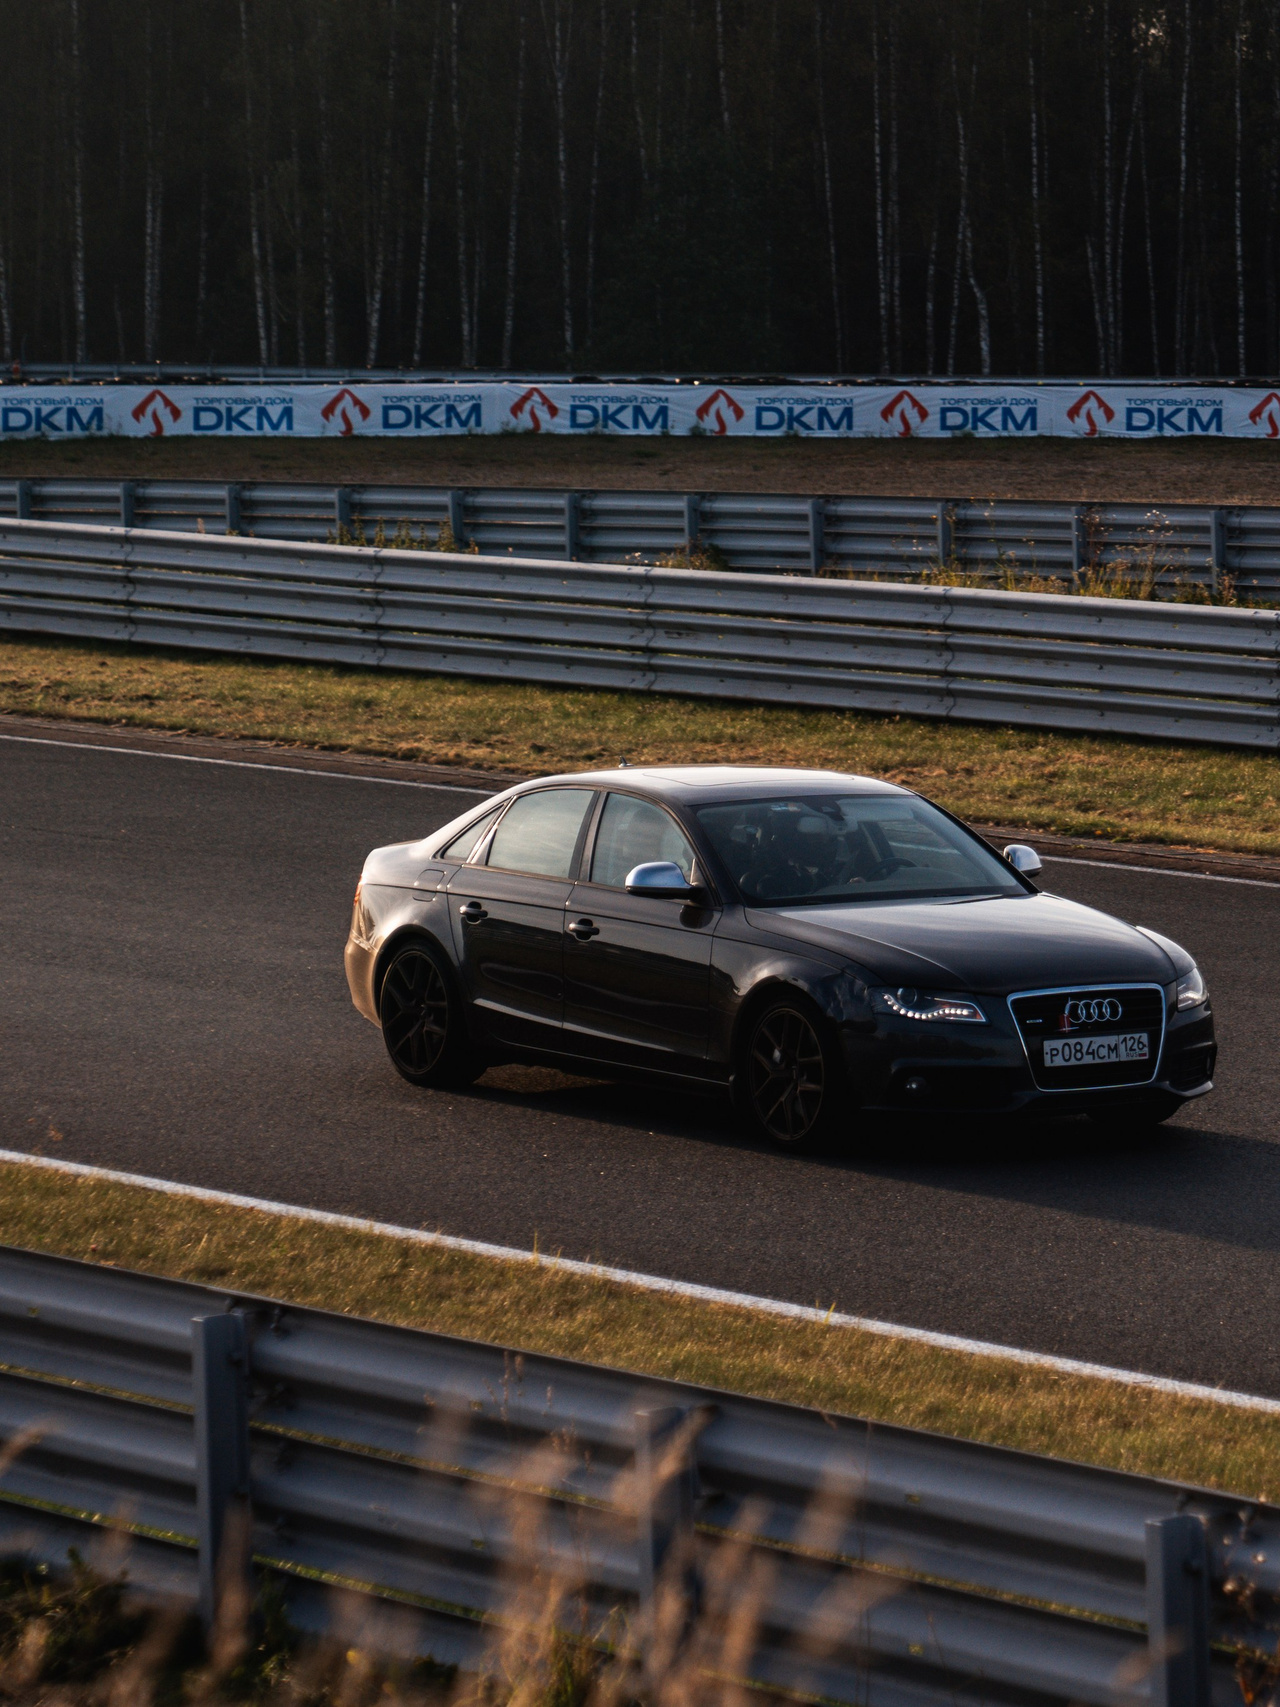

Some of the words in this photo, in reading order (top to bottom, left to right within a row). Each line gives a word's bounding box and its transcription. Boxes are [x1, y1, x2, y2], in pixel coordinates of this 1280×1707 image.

[2, 396, 72, 406] ТОРГОВЫЙ
[75, 396, 104, 406] ДОМ
[193, 396, 262, 406] ТОРГОВЫЙ
[264, 396, 293, 406] ДОМ
[382, 394, 452, 404] ТОРГОВЫЙ
[453, 394, 482, 404] ДОМ
[570, 395, 639, 405] ТОРГОВЫЙ
[640, 395, 669, 405] ДОМ
[755, 397, 824, 406] ТОРГОВЫЙ
[825, 397, 854, 406] ДОМ
[939, 397, 1008, 406] ТОРГОВЫЙ
[1009, 397, 1038, 406] ДОМ
[1125, 398, 1195, 407] ТОРГОВЫЙ
[1196, 398, 1223, 407] ДОМ
[2, 406, 104, 432] DKM
[193, 406, 293, 432] DKM
[382, 403, 482, 430] DKM
[570, 404, 669, 430] DKM
[755, 406, 854, 432] DKM
[939, 406, 1038, 432] DKM
[1125, 407, 1223, 433] DKM
[1120, 1035, 1145, 1052] 126
